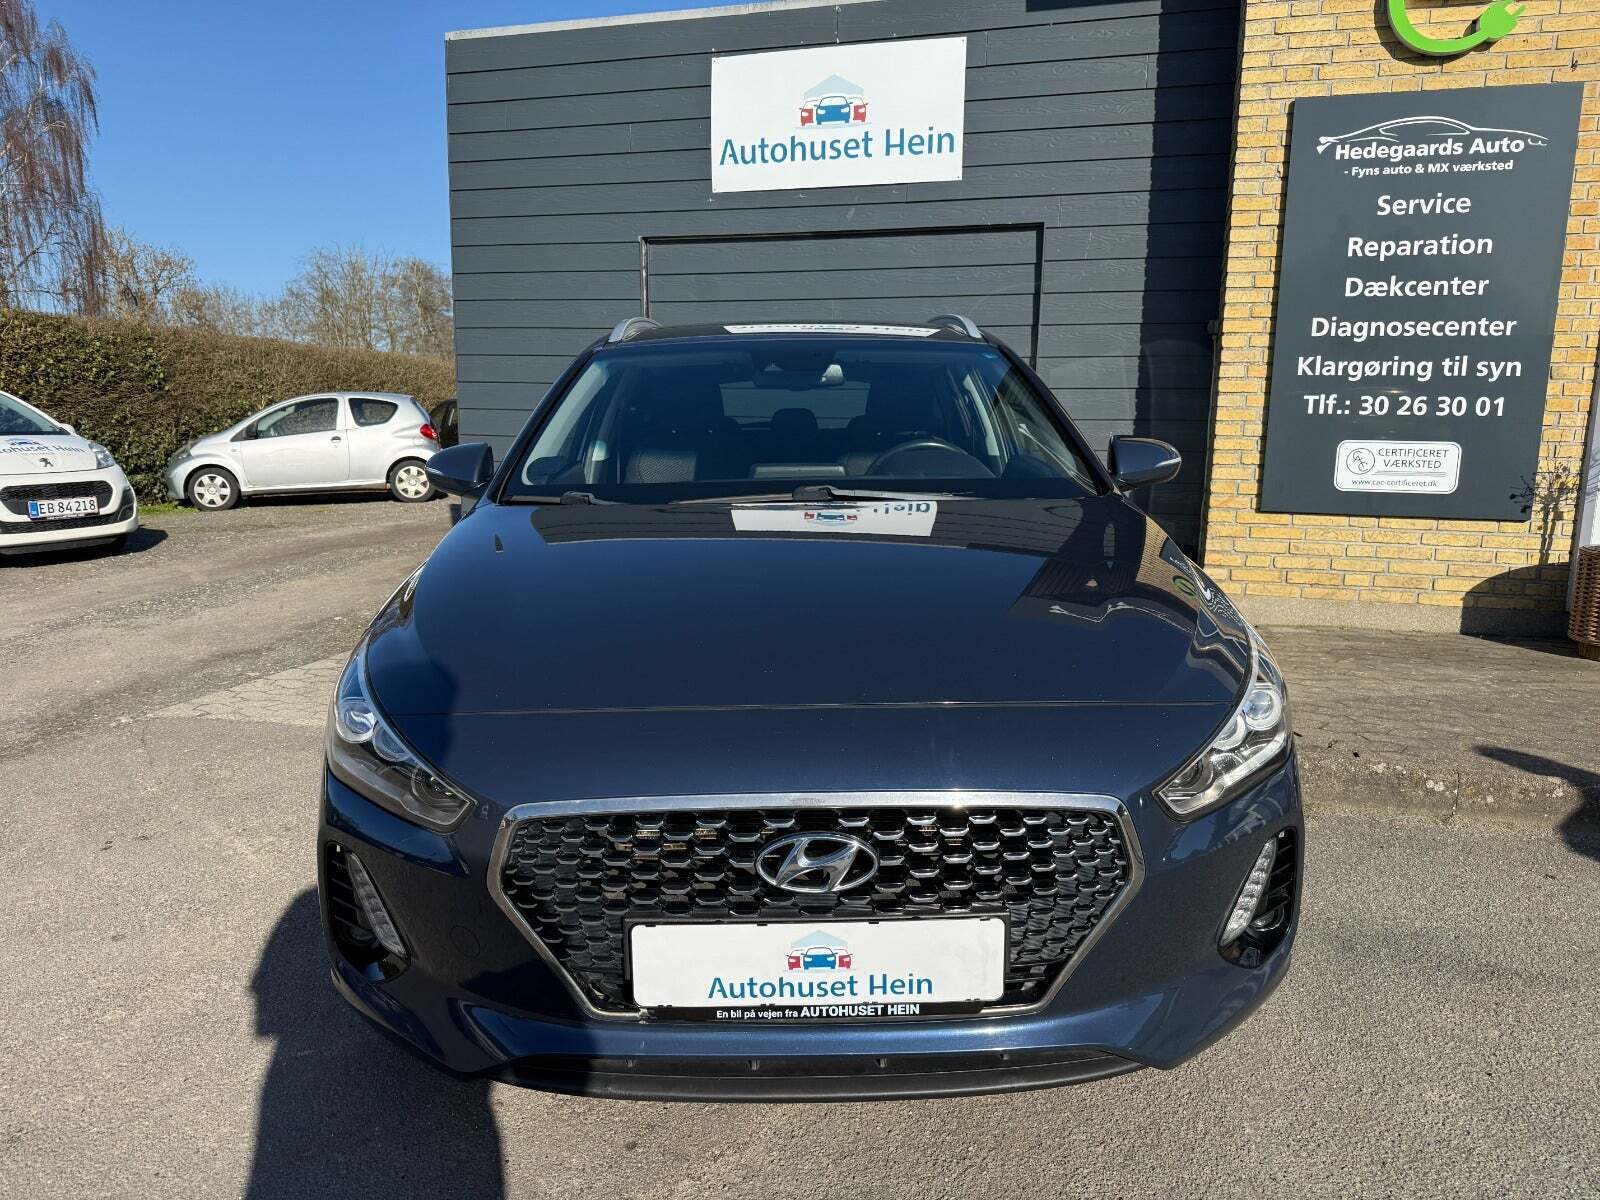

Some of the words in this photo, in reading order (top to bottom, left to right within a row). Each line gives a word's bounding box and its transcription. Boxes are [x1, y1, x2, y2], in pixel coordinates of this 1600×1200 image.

[720, 130, 873, 165] Autohuset
[885, 127, 955, 156] Hein
[1335, 138, 1464, 162] Hedegaards
[1469, 137, 1525, 155] Auto
[1351, 167, 1381, 178] Fyns
[1383, 165, 1411, 175] auto
[1414, 164, 1425, 173] &
[1427, 163, 1450, 173] MX
[1452, 159, 1514, 172] værksted
[1376, 192, 1472, 216] Service
[1347, 233, 1493, 262] Reparation
[1344, 275, 1490, 297] Dækcenter
[1311, 316, 1518, 343] Diagnosecenter
[1297, 355, 1433, 382] Klargøring
[1441, 355, 1469, 377] til
[1476, 360, 1522, 383] syn
[1303, 394, 1351, 416] Tlf.:
[1358, 395, 1390, 416] 30
[1396, 396, 1427, 416] 26
[1435, 396, 1468, 417] 30
[1475, 396, 1505, 417] 01
[1378, 448, 1450, 459] CERTIFICERET
[1383, 459, 1442, 469] VÆRKSTED
[1351, 478, 1437, 488] www.cac-certificeret.dk
[38, 502, 55, 514] EB
[57, 501, 73, 513] 84
[75, 499, 97, 512] 218
[707, 975, 859, 999] Autohuset
[869, 974, 933, 996] Hein
[716, 1010, 729, 1019] En
[730, 1009, 742, 1018] bil
[744, 1008, 756, 1020] på
[757, 1009, 783, 1020] vejen
[784, 1008, 799, 1018] fra
[800, 1004, 885, 1017] AUTOHUSET
[887, 1003, 921, 1016] HEIN
